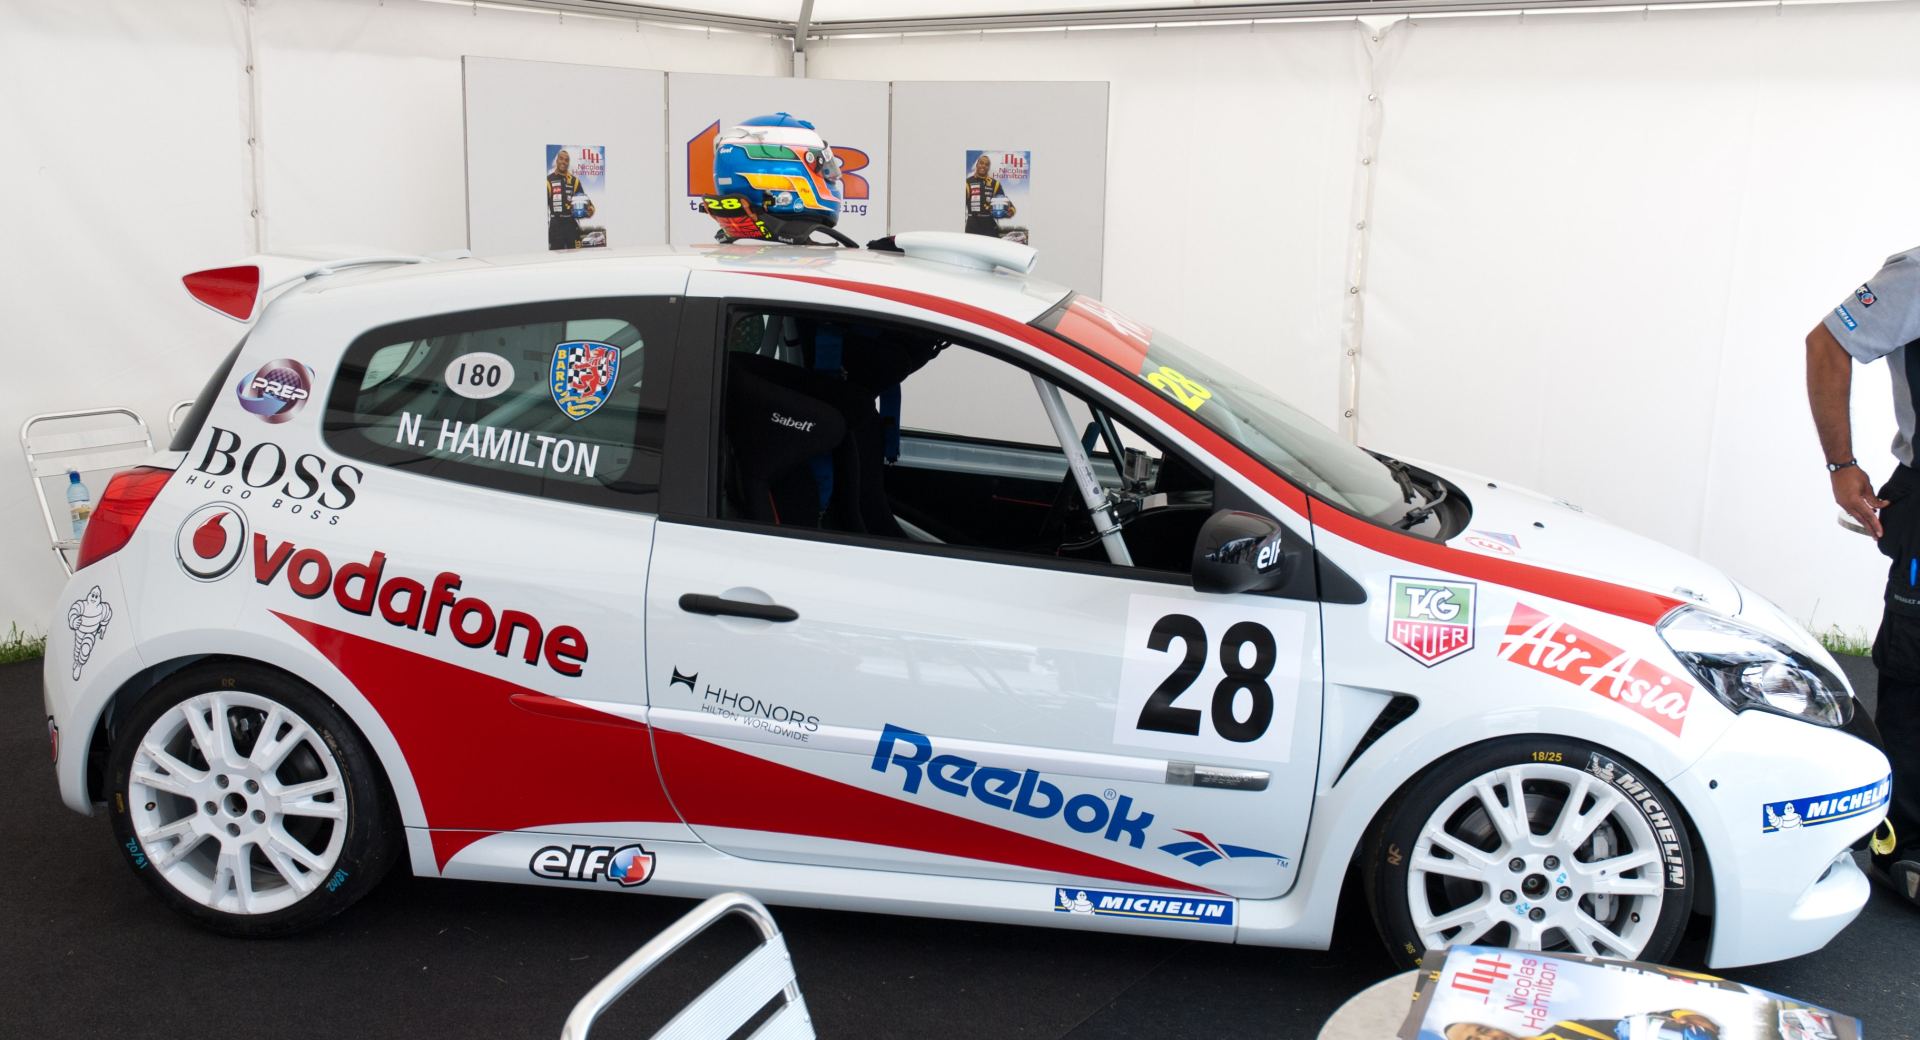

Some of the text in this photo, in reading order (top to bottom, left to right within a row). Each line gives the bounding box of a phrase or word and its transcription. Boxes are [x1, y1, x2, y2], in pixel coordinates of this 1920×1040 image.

[704, 198, 742, 210] 28
[252, 377, 308, 400] PREP
[554, 349, 567, 393] BARC
[1147, 366, 1212, 411] 28
[771, 412, 814, 432] Sabelt
[396, 412, 600, 478] N. HAMILTON
[194, 426, 363, 510] BOSS
[186, 475, 339, 526] HUGO BOSS
[253, 532, 588, 677] vodafone
[1405, 586, 1461, 621] TAG
[1396, 623, 1465, 658] HEUER
[1136, 612, 1277, 743] 28
[701, 703, 809, 743] HILTON WORLDWIDE
[704, 684, 820, 732] HHONORS
[1532, 751, 1562, 762] 18/25
[871, 723, 1155, 849] Reebok
[1806, 780, 1890, 818] MICHELIN
[1616, 773, 1685, 886] MICHELIN
[530, 846, 613, 881] elf
[1099, 895, 1225, 917] MICHELIN
[1504, 958, 1538, 1013] Nicolas
[1522, 962, 1559, 1030] Hamilton
